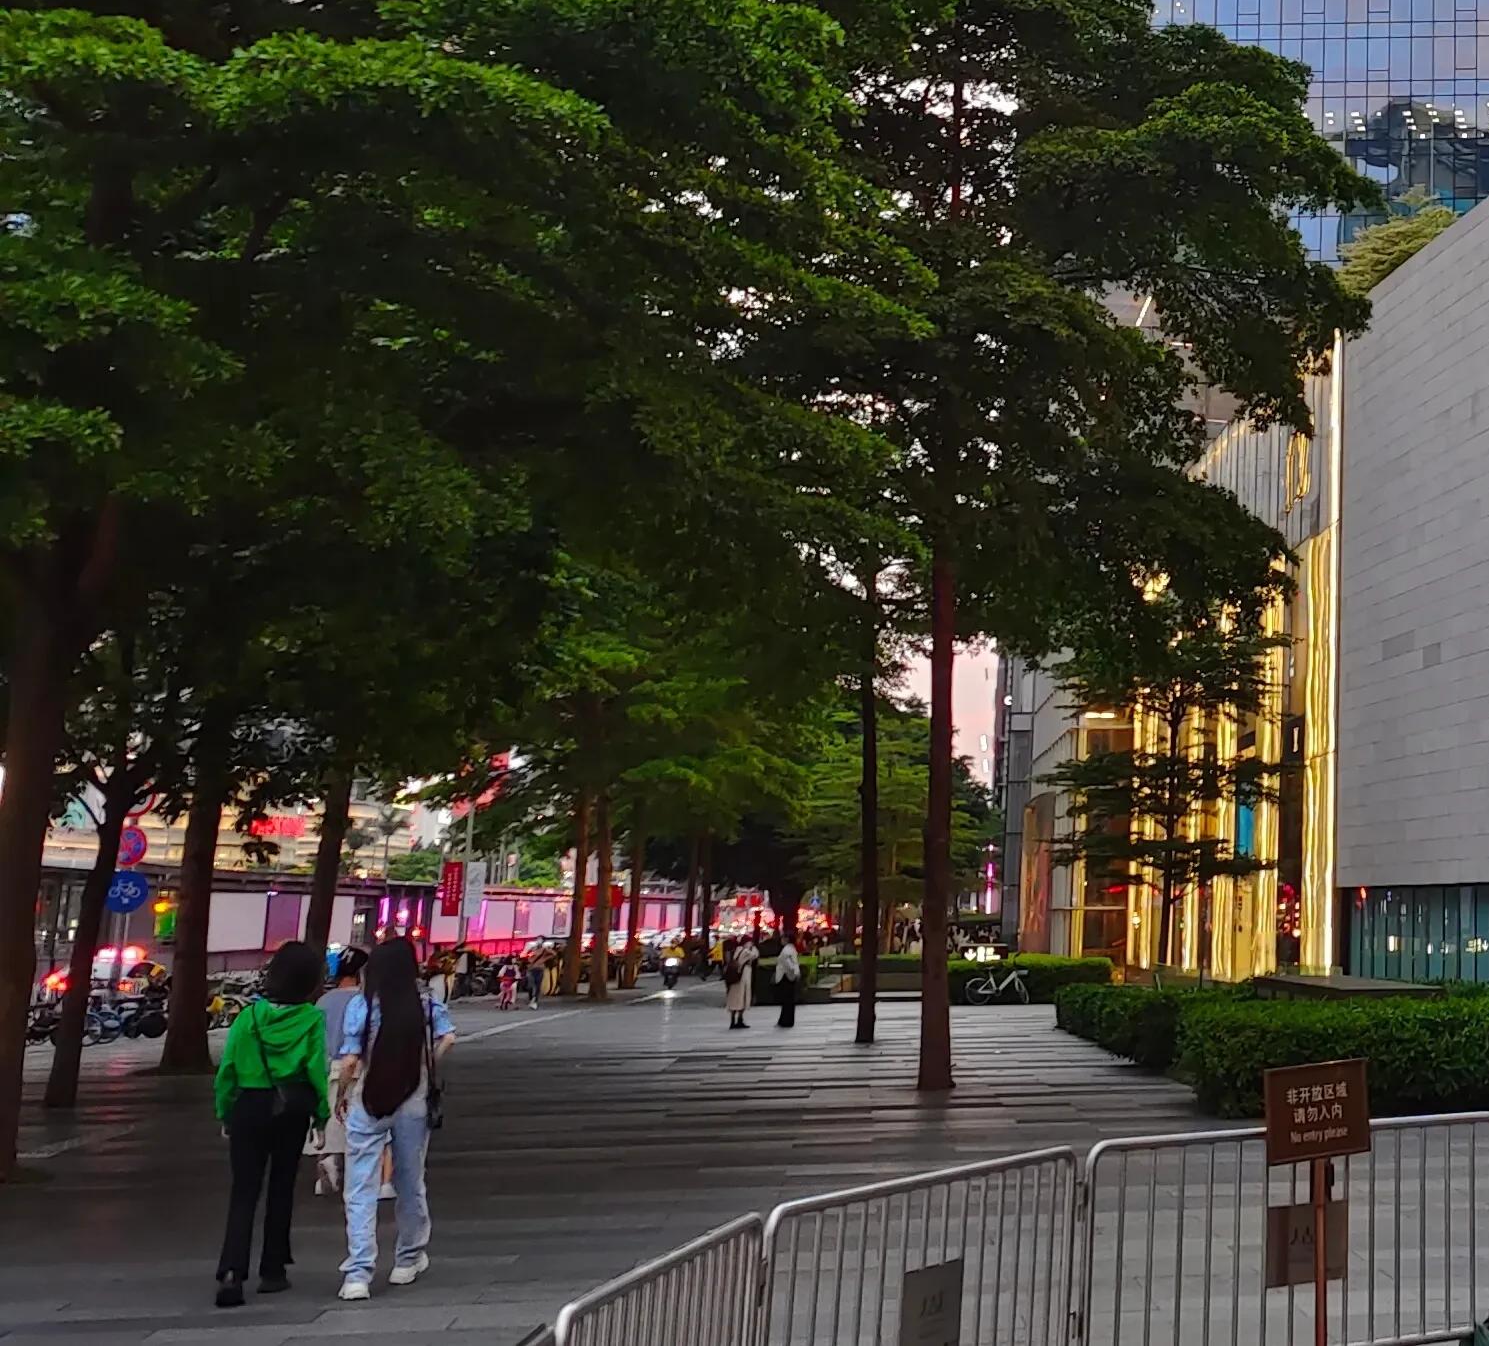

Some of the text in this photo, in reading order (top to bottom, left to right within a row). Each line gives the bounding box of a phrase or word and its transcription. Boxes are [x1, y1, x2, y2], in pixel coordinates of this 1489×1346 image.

[1287, 1082, 1348, 1104] 非开放区域
[1294, 1103, 1343, 1123] 请勿入内
